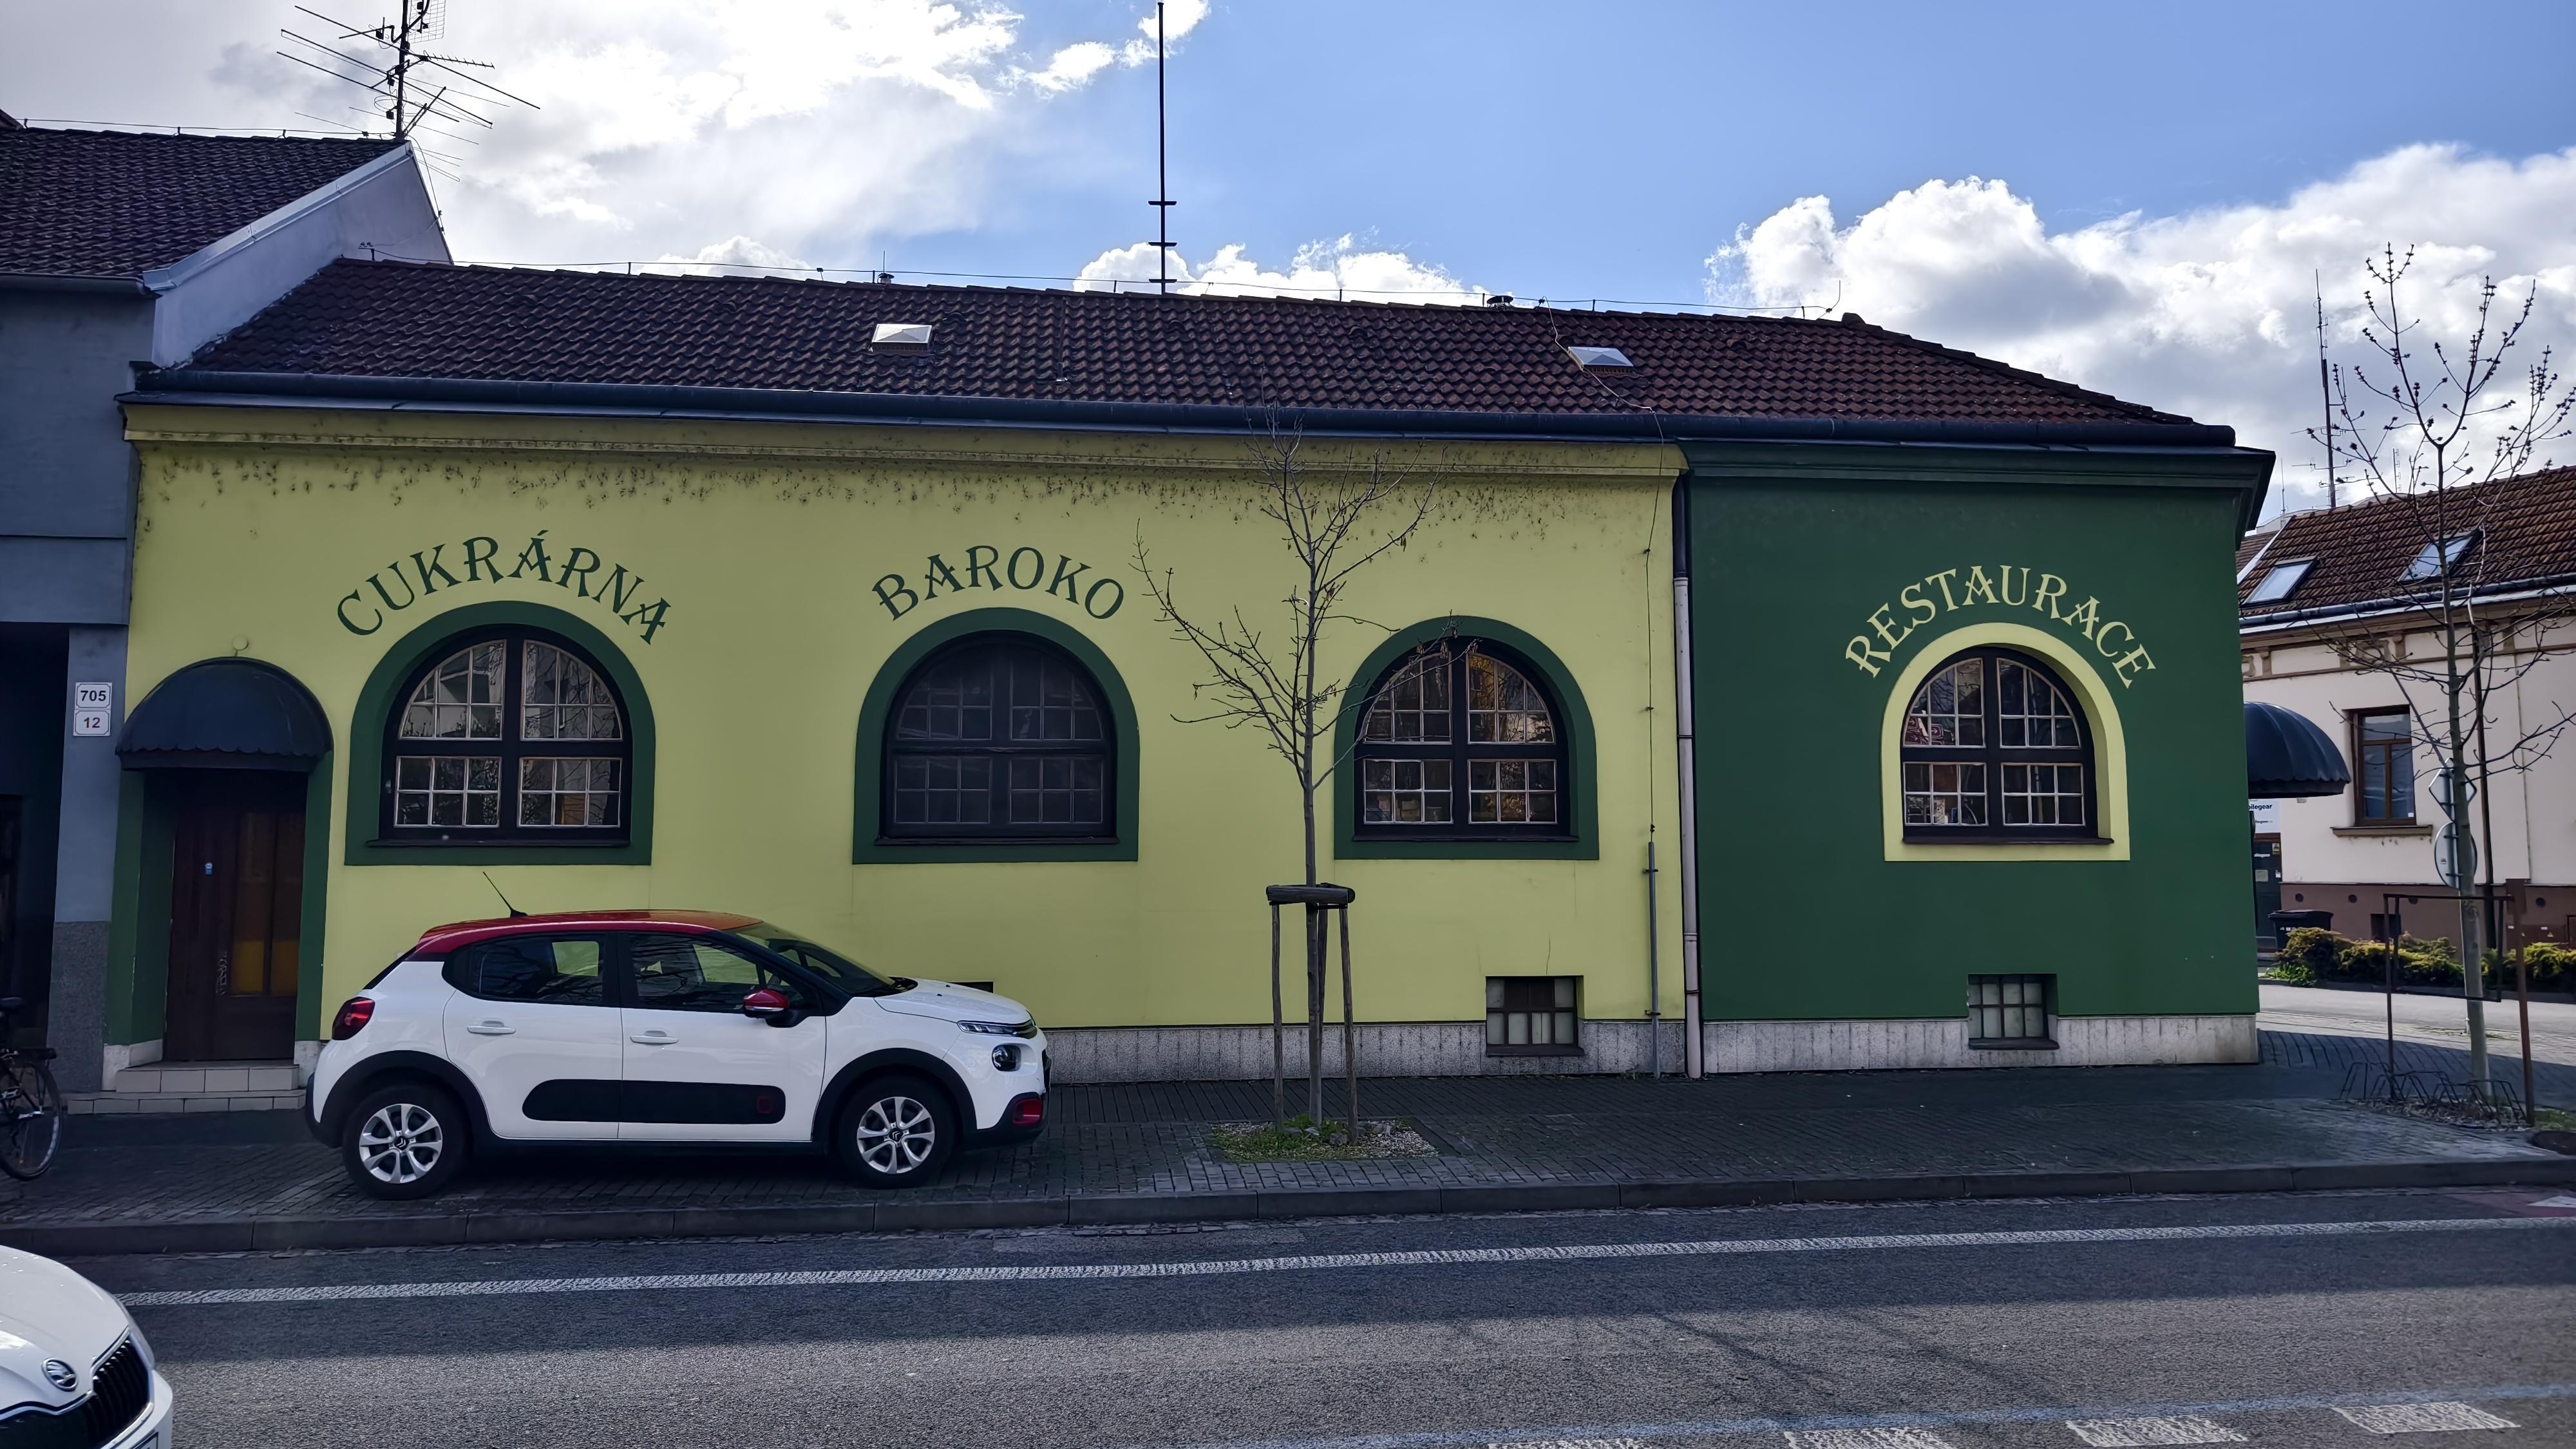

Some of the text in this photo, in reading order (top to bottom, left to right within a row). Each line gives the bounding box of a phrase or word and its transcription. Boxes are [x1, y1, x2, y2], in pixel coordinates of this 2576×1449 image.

[337, 530, 671, 645] CUKRÁRNA
[871, 545, 1124, 621] BAROKO
[1845, 565, 2156, 688] RESTAURACE
[80, 690, 106, 701] 705
[84, 717, 100, 728] 12
